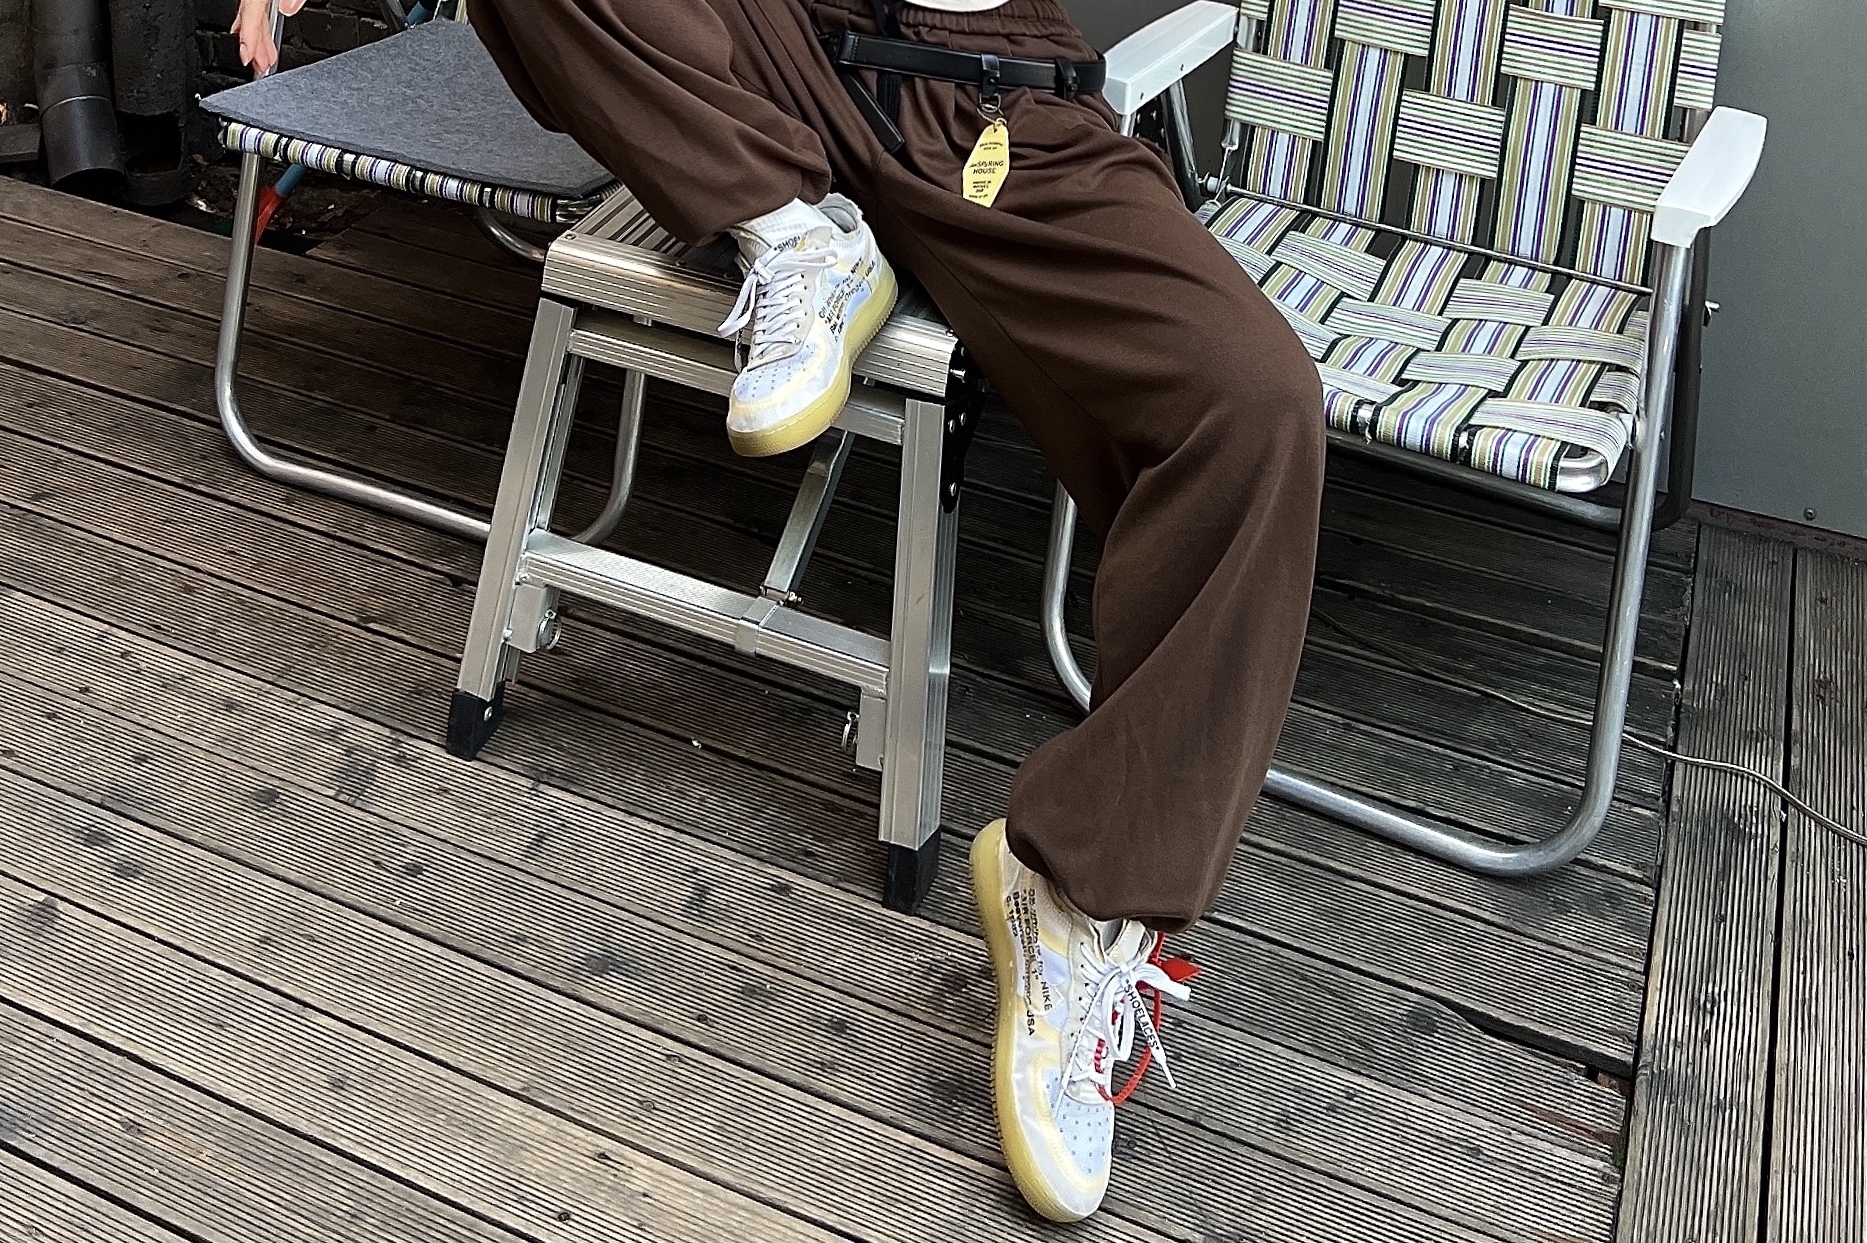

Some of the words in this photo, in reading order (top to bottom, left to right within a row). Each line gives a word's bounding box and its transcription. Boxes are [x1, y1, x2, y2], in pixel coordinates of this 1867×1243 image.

[972, 167, 997, 175] HOUSE
[772, 235, 802, 253] "SHOE
[1040, 981, 1053, 1012] NIKE
[1123, 978, 1160, 1051] "SHOELACES"
